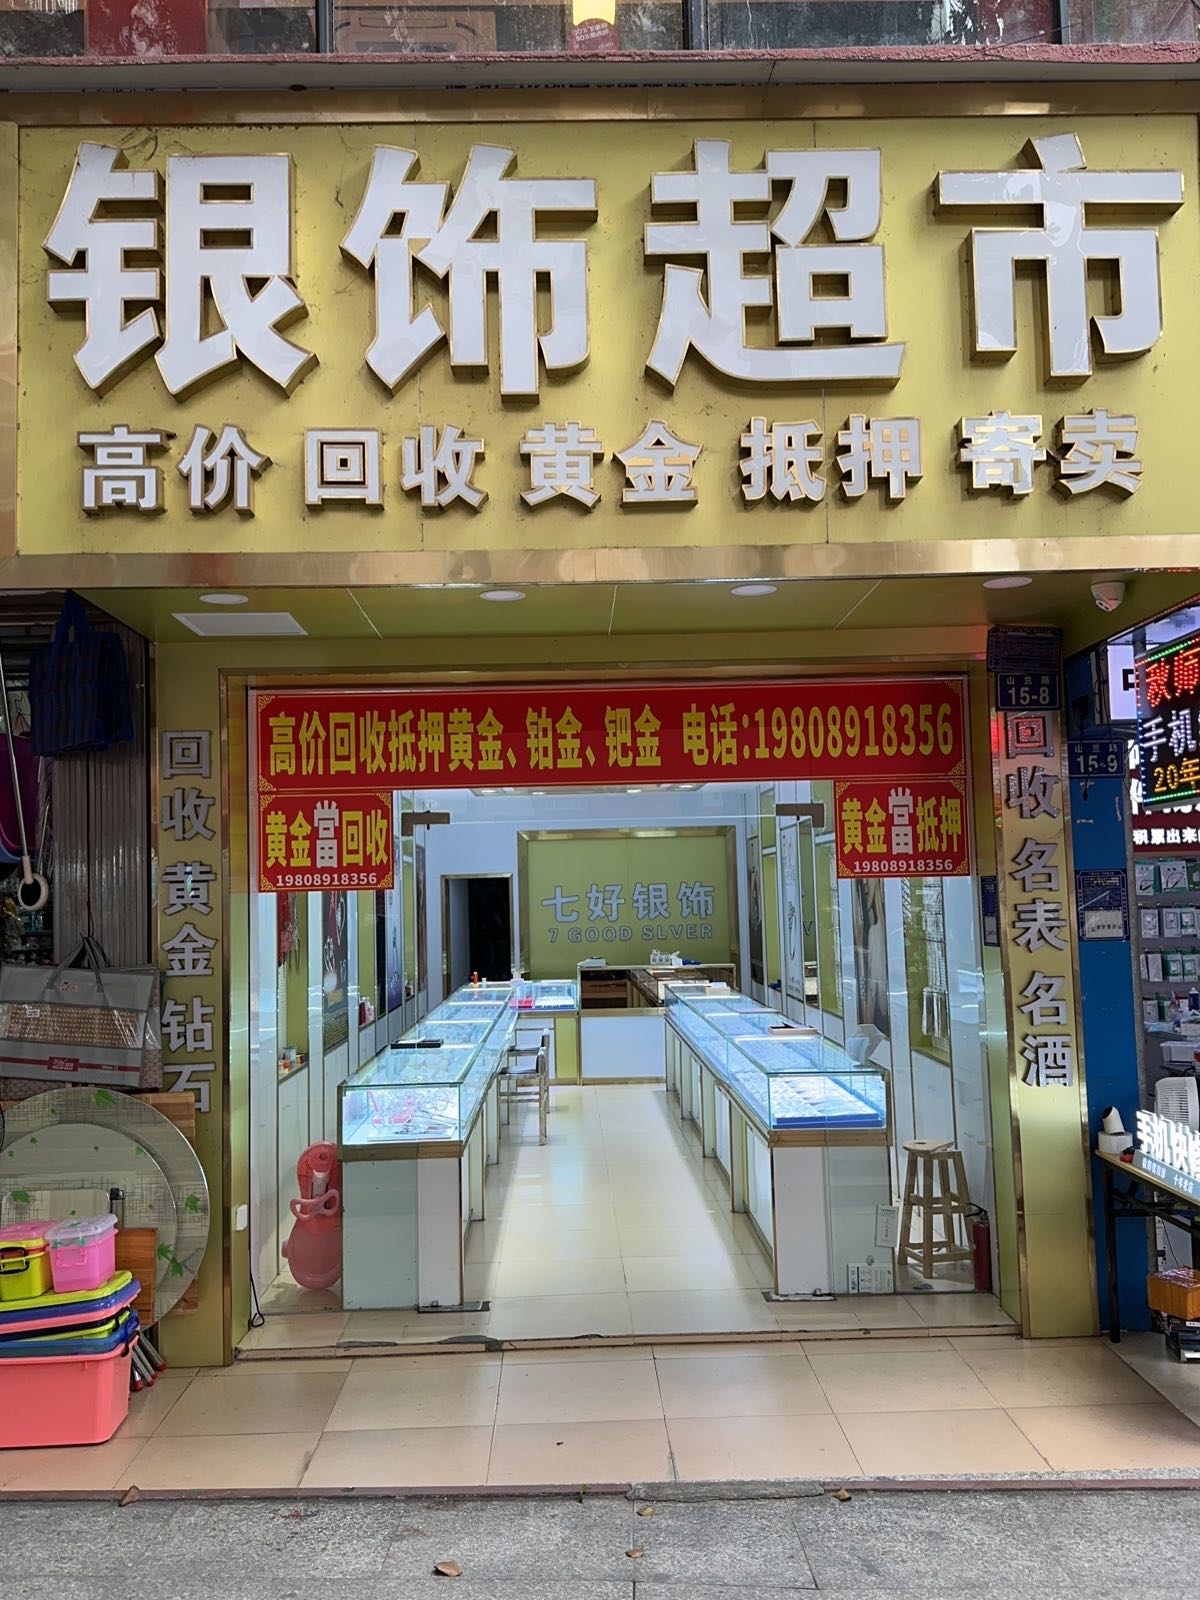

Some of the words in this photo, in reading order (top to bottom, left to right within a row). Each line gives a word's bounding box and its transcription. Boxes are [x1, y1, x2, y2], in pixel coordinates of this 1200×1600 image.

[43, 132, 1184, 399] 银饰超市
[1008, 686, 1050, 705] 15-8
[1142, 708, 1200, 762] 手机
[1077, 754, 1117, 773] 15-9
[1133, 826, 1200, 845] 积累出来
[854, 860, 953, 873] 19808918356
[276, 873, 377, 886] 19808918356
[541, 881, 715, 923] 七好银饰
[1006, 711, 1073, 1087] 回收名表名酒
[161, 731, 217, 1112] 回收黄金钻石
[548, 928, 559, 943] 7
[568, 926, 633, 942] GOOD
[641, 924, 713, 940] SLVER
